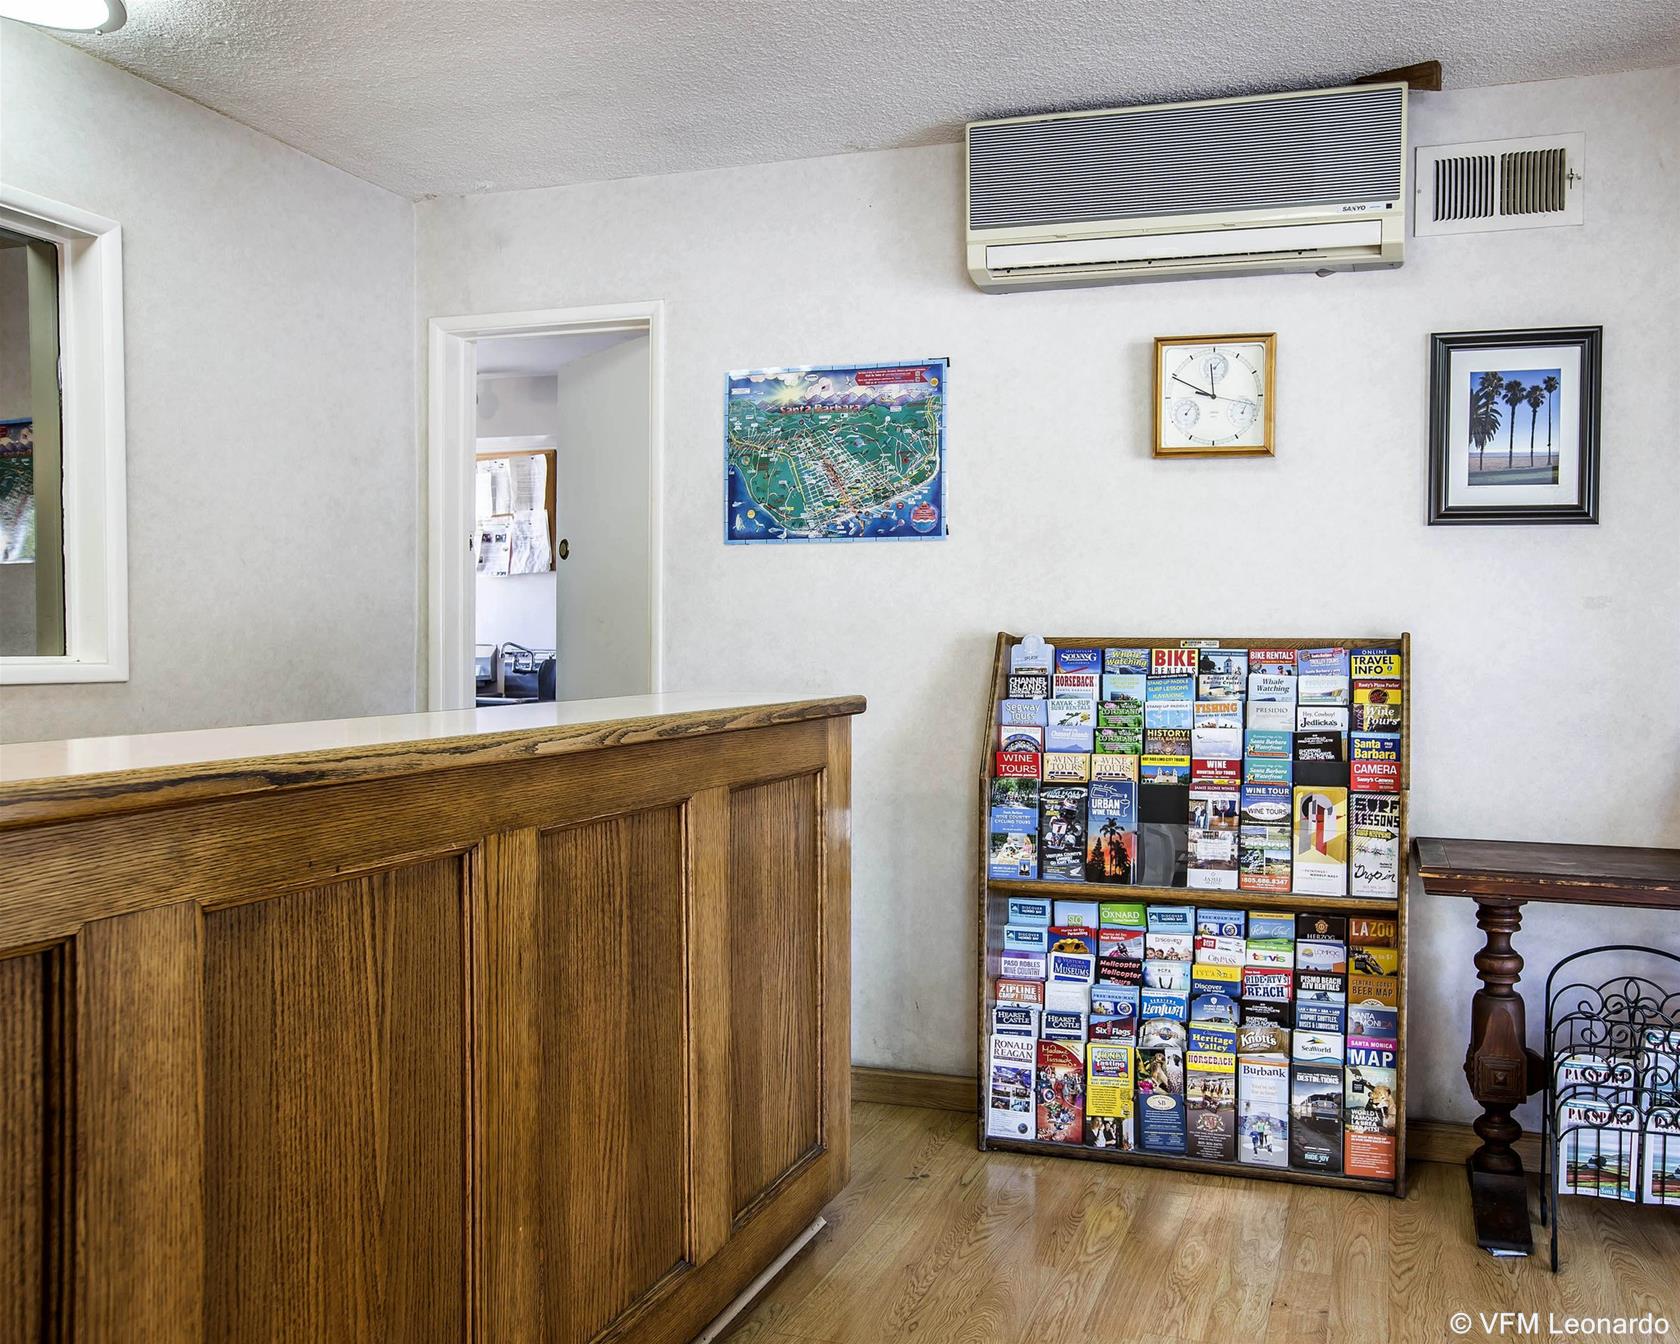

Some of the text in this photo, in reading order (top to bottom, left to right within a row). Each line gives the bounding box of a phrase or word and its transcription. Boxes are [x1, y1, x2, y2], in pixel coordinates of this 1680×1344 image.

[1155, 650, 1196, 666] BIKE
[1355, 666, 1383, 674] INFO
[1056, 676, 1094, 687] HORSEBACK
[1257, 685, 1290, 693] Watching
[1006, 703, 1040, 713] Segway
[1196, 703, 1237, 713] FISHING
[1366, 706, 1394, 715] Wine
[1366, 716, 1398, 725] Tours
[1354, 740, 1380, 748] Santa
[1354, 749, 1396, 759] Barbara
[1000, 765, 1037, 773] TOURS
[1098, 764, 1131, 772] TOURS
[1354, 764, 1397, 774] CAMERA
[1092, 799, 1120, 809] URBAN
[1355, 798, 1400, 813] SURF
[1355, 813, 1400, 828] LESSONS
[1352, 921, 1394, 937] LA ZOO
[1252, 953, 1286, 962] tervis
[1100, 960, 1140, 968] Helicopter
[1055, 963, 1089, 976] MUSEUMS
[1101, 968, 1141, 979] Helicopter
[1111, 977, 1130, 985] Tours
[1321, 976, 1341, 985] BEACH
[1000, 986, 1036, 994] ZIPLINE
[1247, 986, 1284, 997] BEACH
[1376, 988, 1393, 996] MAP
[1351, 1012, 1375, 1020] SANTA
[1112, 1028, 1131, 1036] Flags
[1192, 1034, 1234, 1045] Heritage
[1241, 1032, 1277, 1047] Knott's
[994, 1039, 1033, 1051] RONALD
[1198, 1042, 1227, 1053] Valley
[994, 1048, 1032, 1059] REAGAN
[1351, 1049, 1393, 1066] MAP
[1188, 1054, 1233, 1066] HORSEBACK
[1243, 1066, 1285, 1078] Burbank
